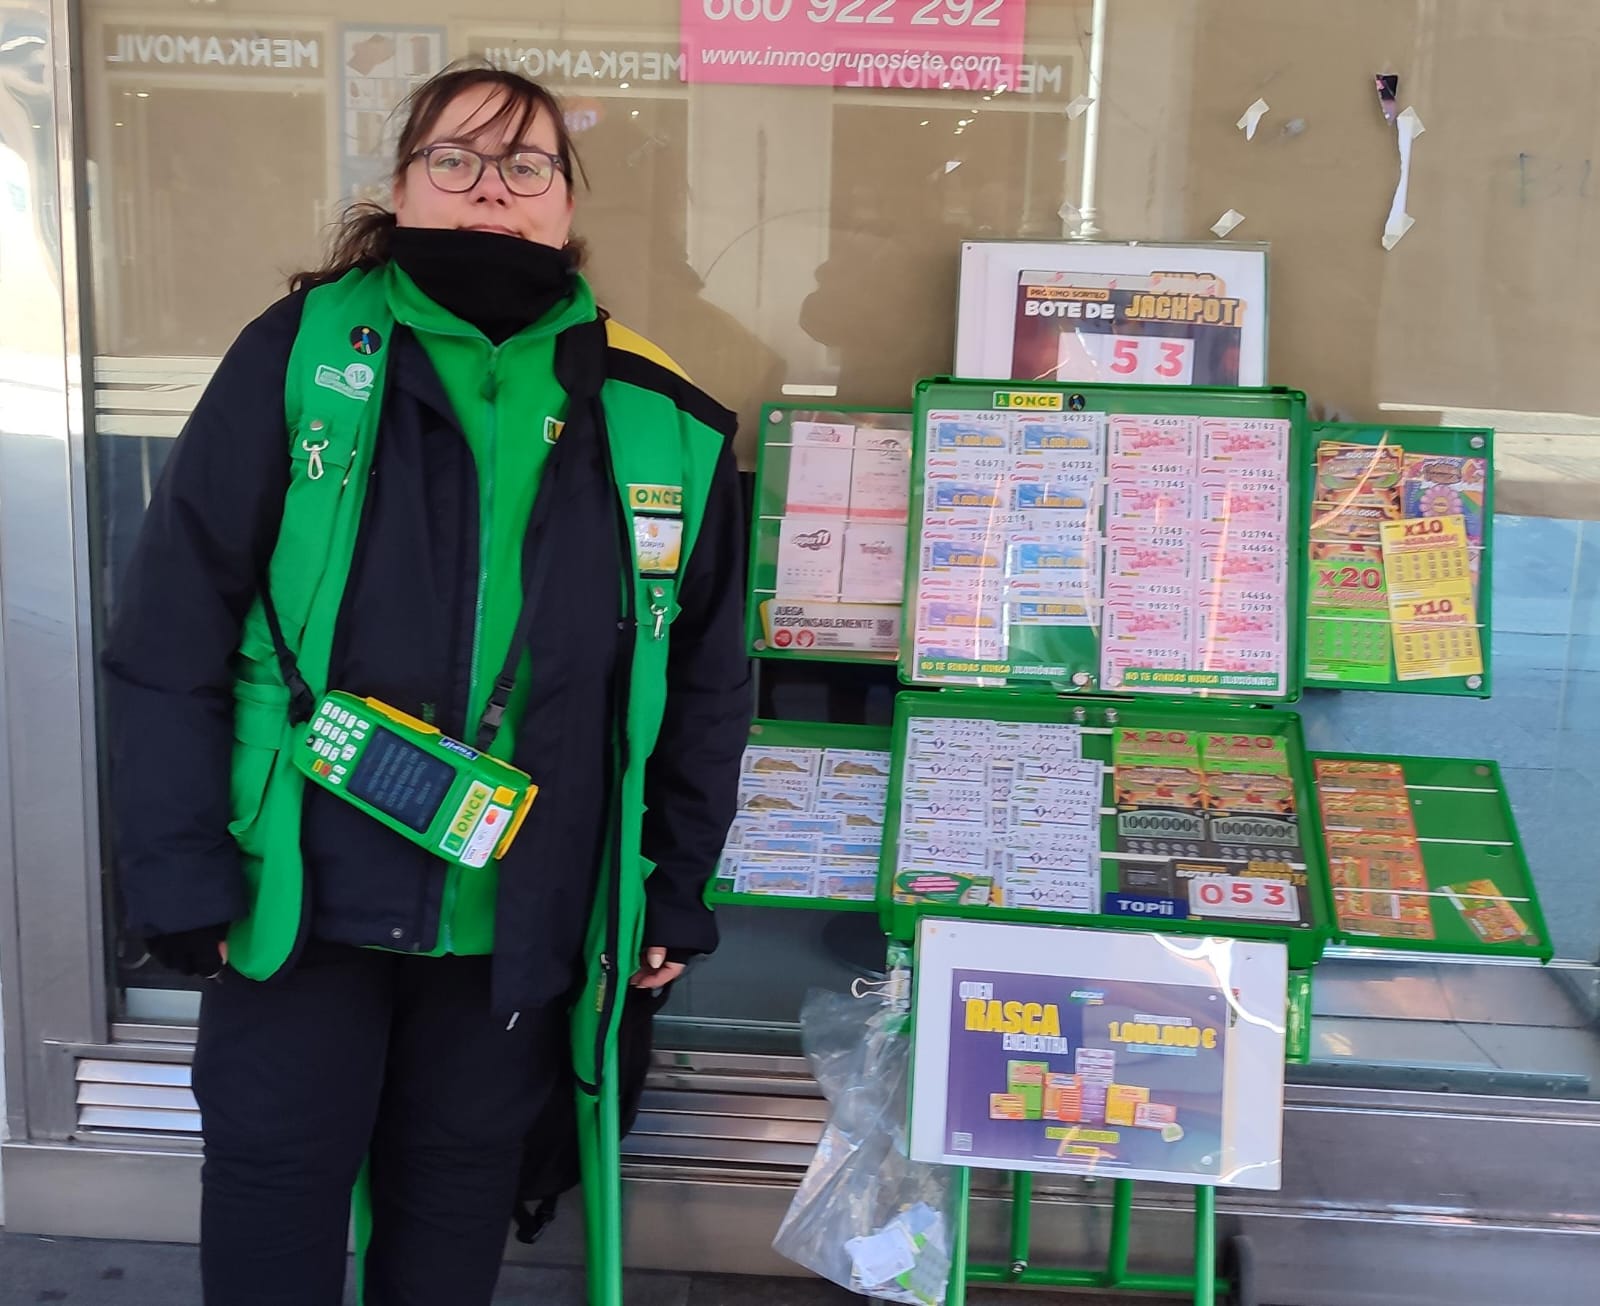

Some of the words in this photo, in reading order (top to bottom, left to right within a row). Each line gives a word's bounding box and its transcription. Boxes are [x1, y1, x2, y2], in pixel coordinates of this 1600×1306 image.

[701, 46, 1002, 72] www.inmogruposiete.com
[1025, 301, 1082, 319] BOTE
[1085, 302, 1115, 320] DE
[1125, 293, 1240, 324] JACKPOT
[1013, 395, 1058, 407] ONCE
[636, 489, 682, 505] ONCE
[774, 606, 805, 616] JUEGA
[773, 617, 874, 629] RESPONSABLEMENTE
[456, 788, 488, 833] ONCE
[965, 998, 1061, 1036] RASCA
